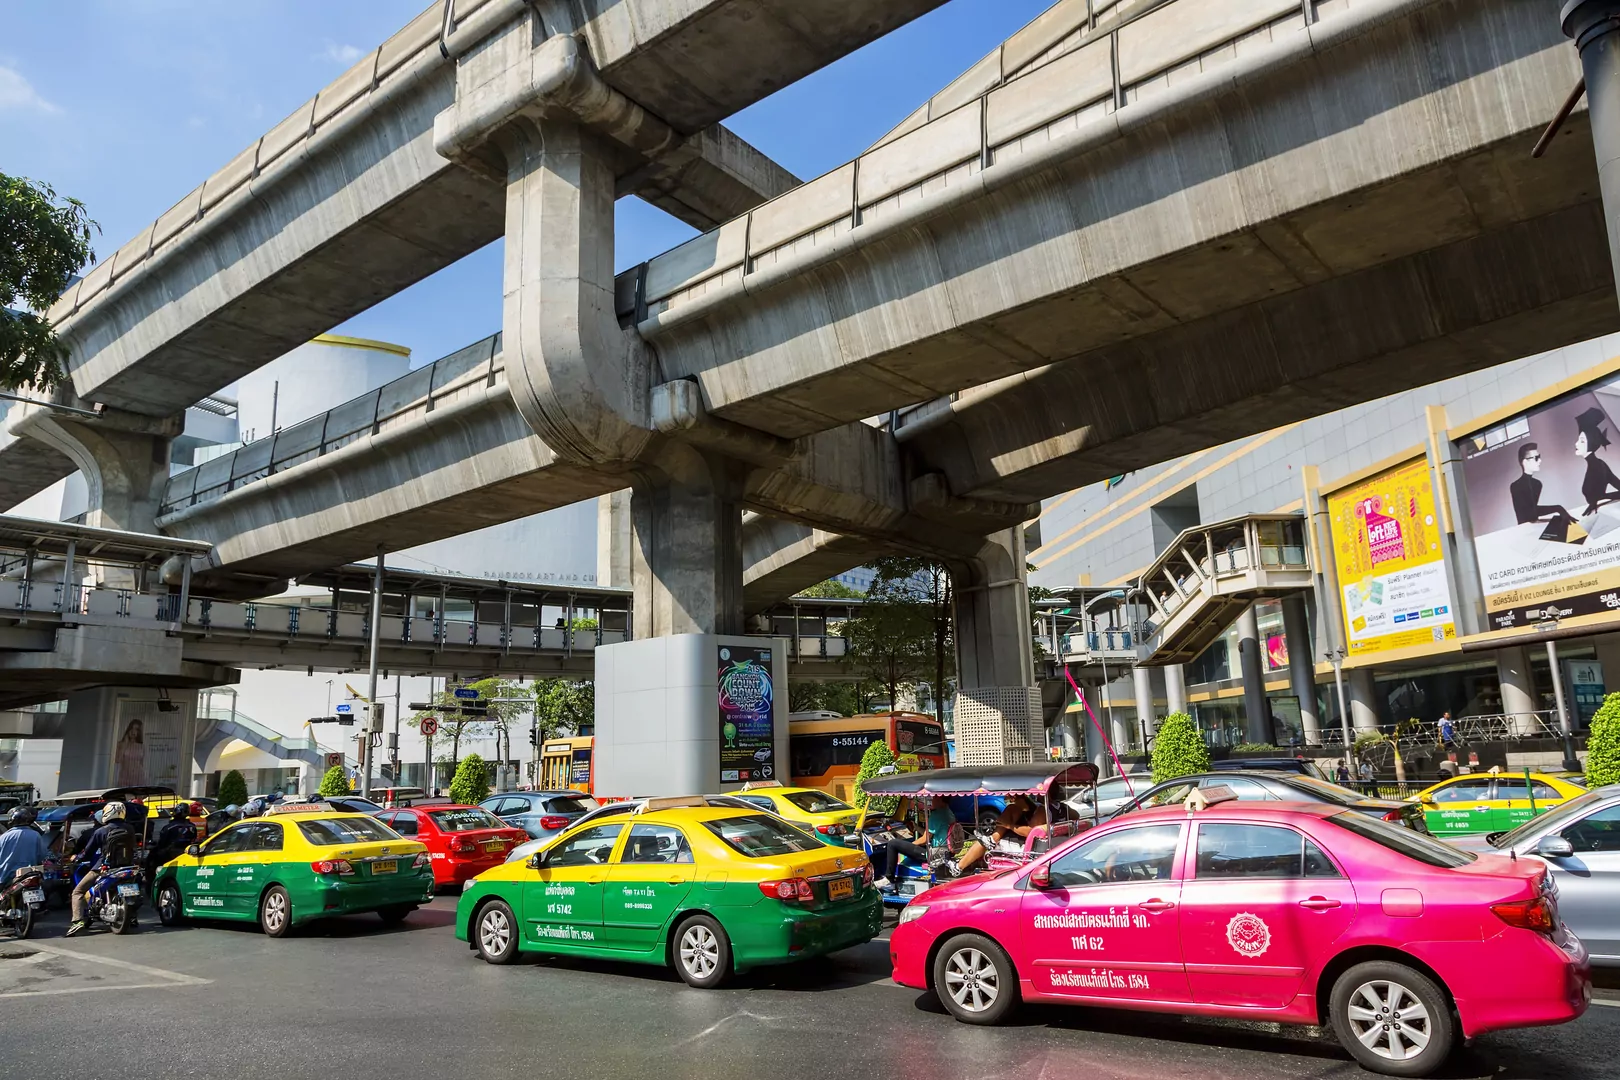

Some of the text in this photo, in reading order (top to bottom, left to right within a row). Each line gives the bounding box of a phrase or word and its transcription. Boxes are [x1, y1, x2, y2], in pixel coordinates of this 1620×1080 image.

[536, 572, 555, 581] ART
[1403, 571, 1422, 581] Planner
[1488, 572, 1498, 581] VIZ
[1499, 568, 1516, 579] CARD
[1524, 592, 1533, 600] VIZ
[1532, 588, 1554, 599] LOUNGE
[747, 664, 760, 673] AIS
[731, 673, 760, 681] BANGKOK
[732, 679, 760, 689] COUNT
[732, 688, 761, 697] DOWN
[556, 904, 572, 914] 5742
[1034, 906, 1151, 929] สหกรณ์สหมิตรแท็กซี่ จก.
[1089, 936, 1105, 950] 62
[1050, 968, 1108, 988] ร้องเรียนแท็กซี่
[1128, 974, 1150, 989] 1584
